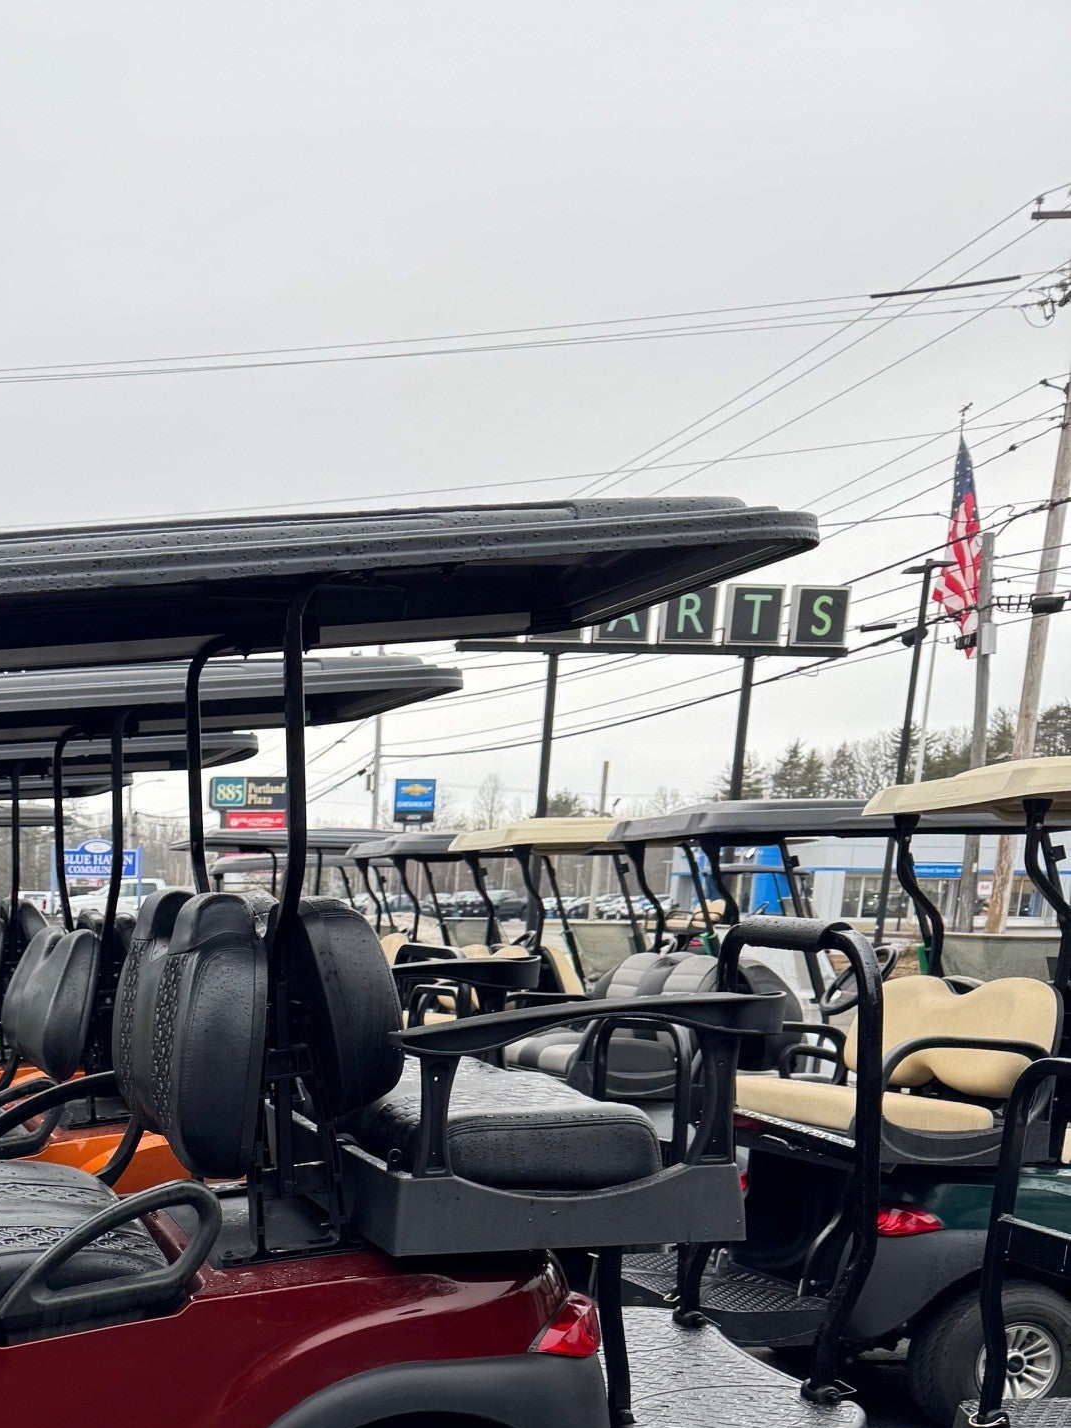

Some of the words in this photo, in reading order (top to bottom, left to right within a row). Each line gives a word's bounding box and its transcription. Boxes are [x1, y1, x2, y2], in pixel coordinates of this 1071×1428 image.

[606, 592, 834, 637] ARTS
[217, 784, 243, 802] 885
[247, 783, 287, 794] Portland
[93, 854, 133, 865] HAN
